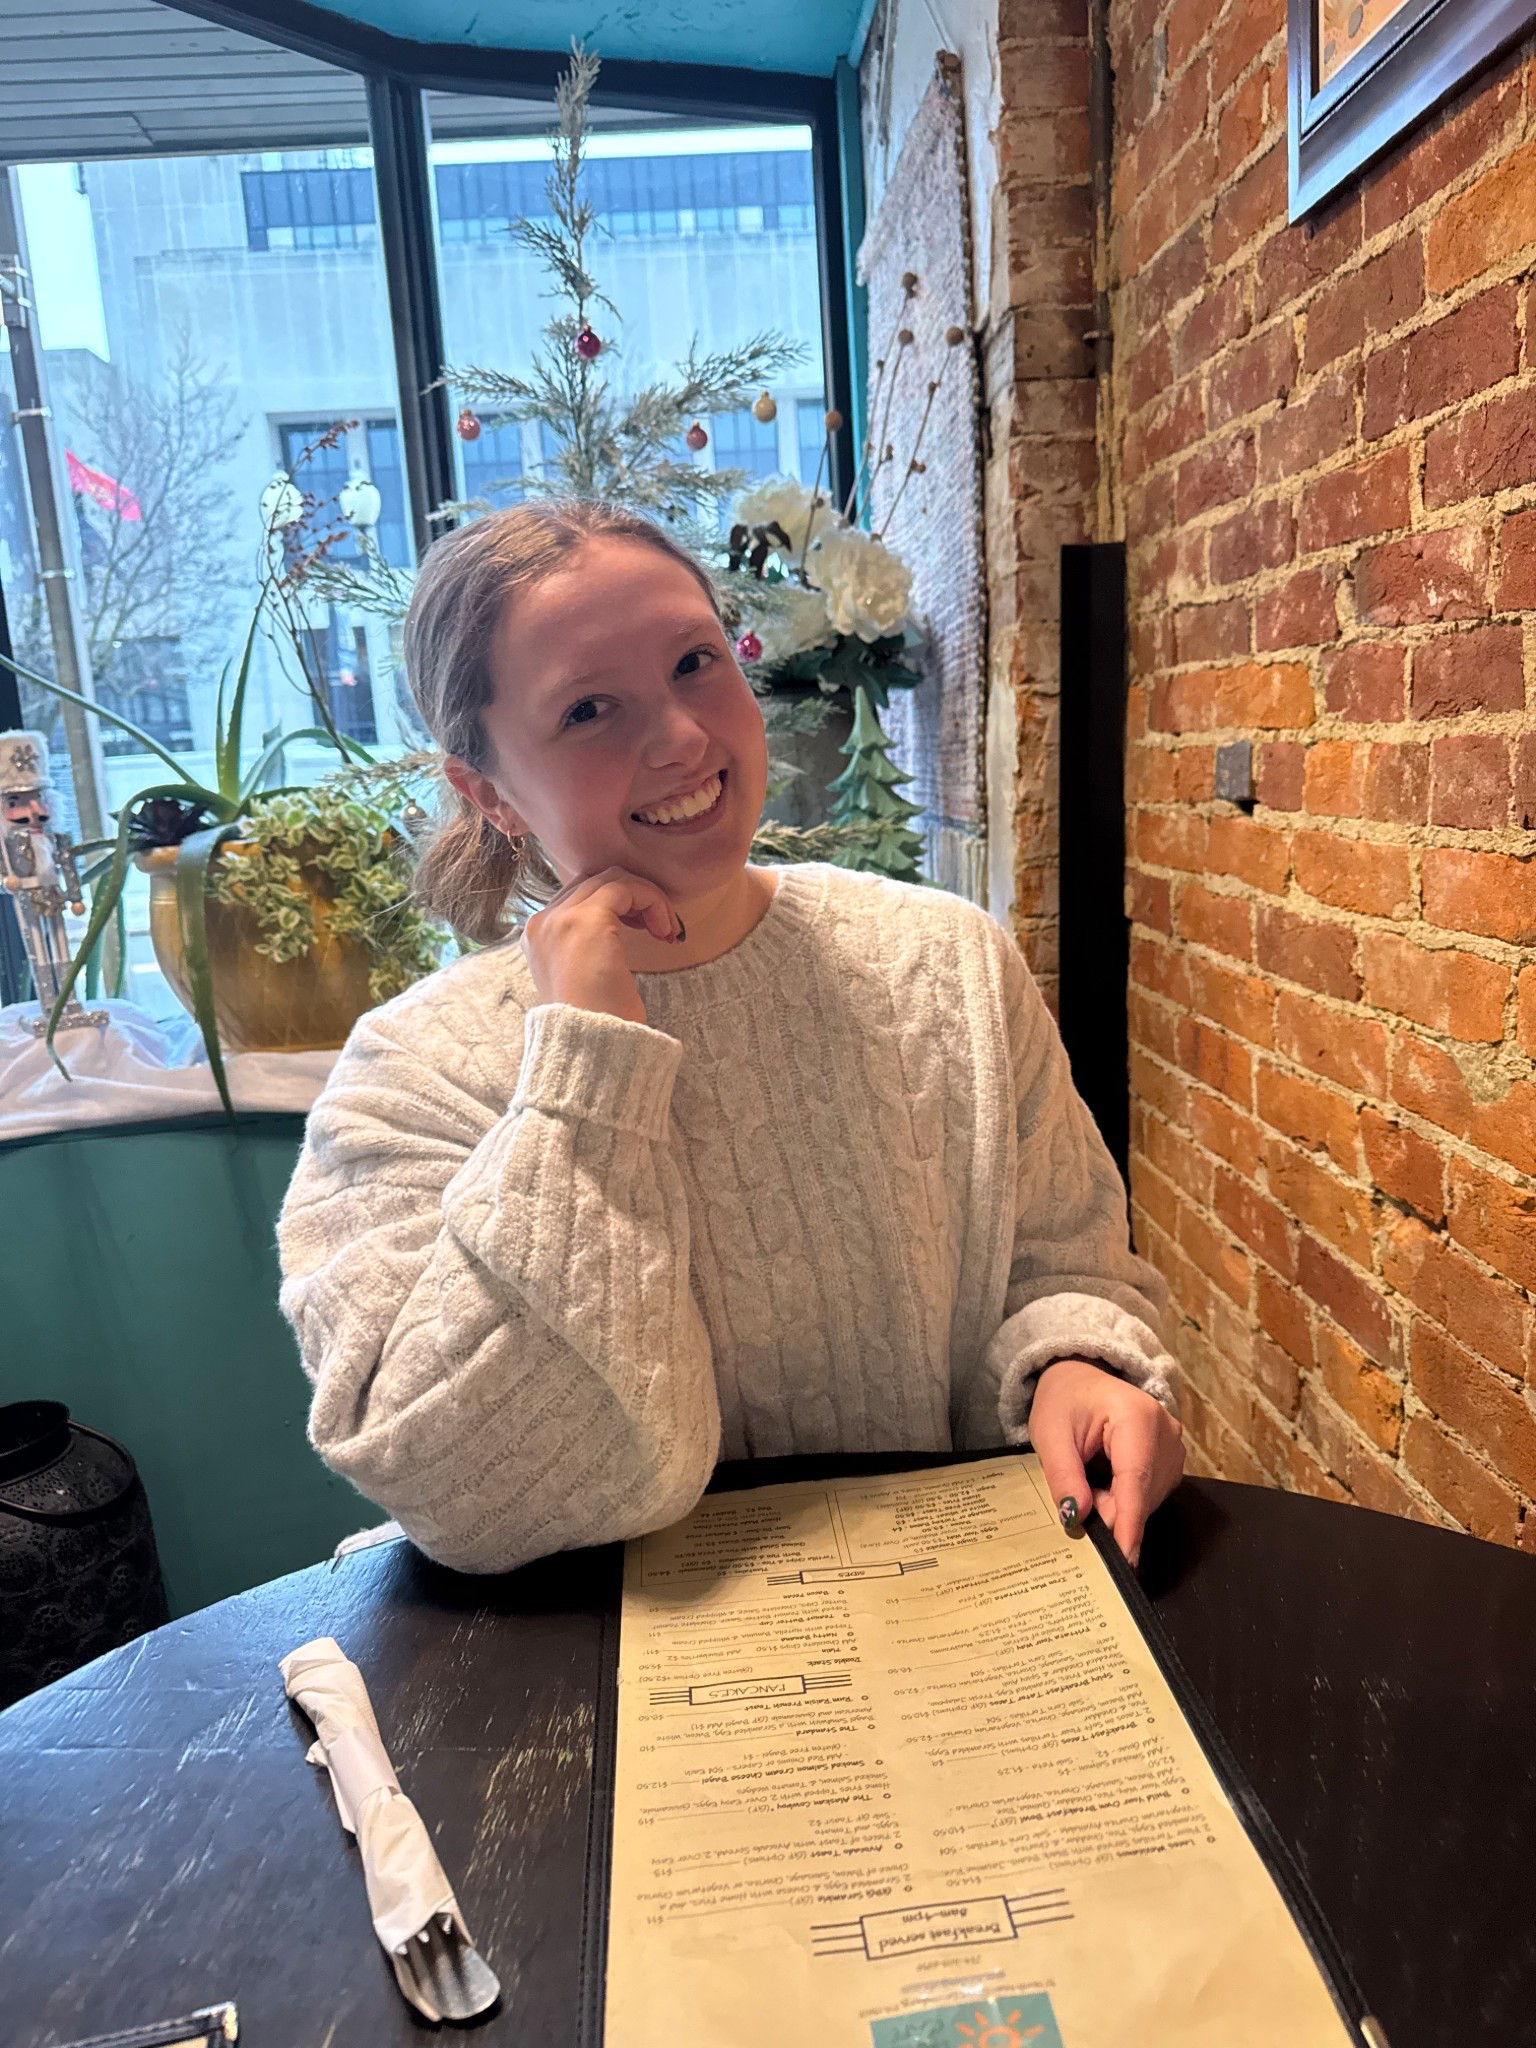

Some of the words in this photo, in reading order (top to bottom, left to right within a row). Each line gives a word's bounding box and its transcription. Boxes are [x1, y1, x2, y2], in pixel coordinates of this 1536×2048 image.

[1048, 1576, 1067, 1586] Iron
[1030, 1582, 1047, 1591] Man
[780, 1634, 810, 1642] Banana
[802, 1639, 839, 1647] Chocolate
[1034, 1636, 1053, 1646] Your
[1015, 1641, 1033, 1650] Way
[833, 1656, 861, 1664] Double
[1089, 1670, 1113, 1683] Spicy
[708, 1682, 785, 1699] PANCAKES
[1044, 1679, 1090, 1696] Breakfast
[1017, 1691, 1044, 1702] Tator
[744, 1703, 770, 1711] Toast
[772, 1700, 802, 1709] French
[988, 1697, 1015, 1707] Tacos
[834, 1706, 872, 1715] American
[931, 1703, 967, 1716] Options)
[770, 1712, 815, 1721] Guacamole
[849, 1713, 874, 1722] Bagel
[900, 1710, 929, 1720] $10.50
[1115, 1710, 1141, 1722] Tacos
[725, 1717, 748, 1727] Bagel
[809, 1717, 847, 1726] Sandwich
[1083, 1720, 1103, 1731] Soft
[734, 1724, 776, 1734] Scrambled
[795, 1726, 837, 1736] Standard
[1058, 1726, 1082, 1736] Flour
[1089, 1721, 1137, 1740] Breakfast
[1019, 1731, 1056, 1743] Tortillas
[1060, 1734, 1088, 1745] Tacos
[811, 1743, 840, 1752] Gluten
[997, 1738, 1018, 1747] with
[762, 1748, 787, 1758] Bagel
[789, 1746, 809, 1754] Free
[951, 1742, 995, 1754] Scrambled
[1000, 1742, 1039, 1756] Options)
[776, 1756, 804, 1766] Onions
[807, 1754, 824, 1762] Red
[826, 1752, 842, 1760] Add
[731, 1760, 762, 1770] Capers
[796, 1763, 828, 1773] Salmon
[830, 1759, 864, 1769] Smoked
[684, 1768, 704, 1776] Each
[730, 1771, 762, 1781] Cheese
[765, 1768, 794, 1777] Cream
[854, 1772, 887, 1782] Smoked
[701, 1774, 728, 1784] Bagel
[636, 1780, 668, 1790] $12.50
[771, 1781, 806, 1791] Tomato
[838, 1785, 861, 1794] Fries
[864, 1781, 890, 1790] Home
[780, 1792, 801, 1800] with
[803, 1786, 836, 1797] Topped
[1145, 1790, 1171, 1801] Build
[720, 1797, 741, 1807] Easy
[744, 1795, 767, 1804] Over
[813, 1796, 850, 1807] Alaskan
[852, 1793, 872, 1802] The
[1122, 1796, 1145, 1806] Your
[776, 1799, 810, 1811] Cowboy
[1097, 1800, 1121, 1810] Own
[1045, 1804, 1096, 1818] Breakfast
[824, 1816, 850, 1826] Toast
[1018, 1812, 1043, 1823] Bowl
[814, 1826, 850, 1836] Tomato
[853, 1824, 871, 1832] and
[932, 1824, 965, 1836] $10.50
[810, 1848, 841, 1859] Toast
[842, 1844, 883, 1856] Avocado
[927, 1921, 1000, 1943] Breakfast
[878, 1932, 925, 1951] served
